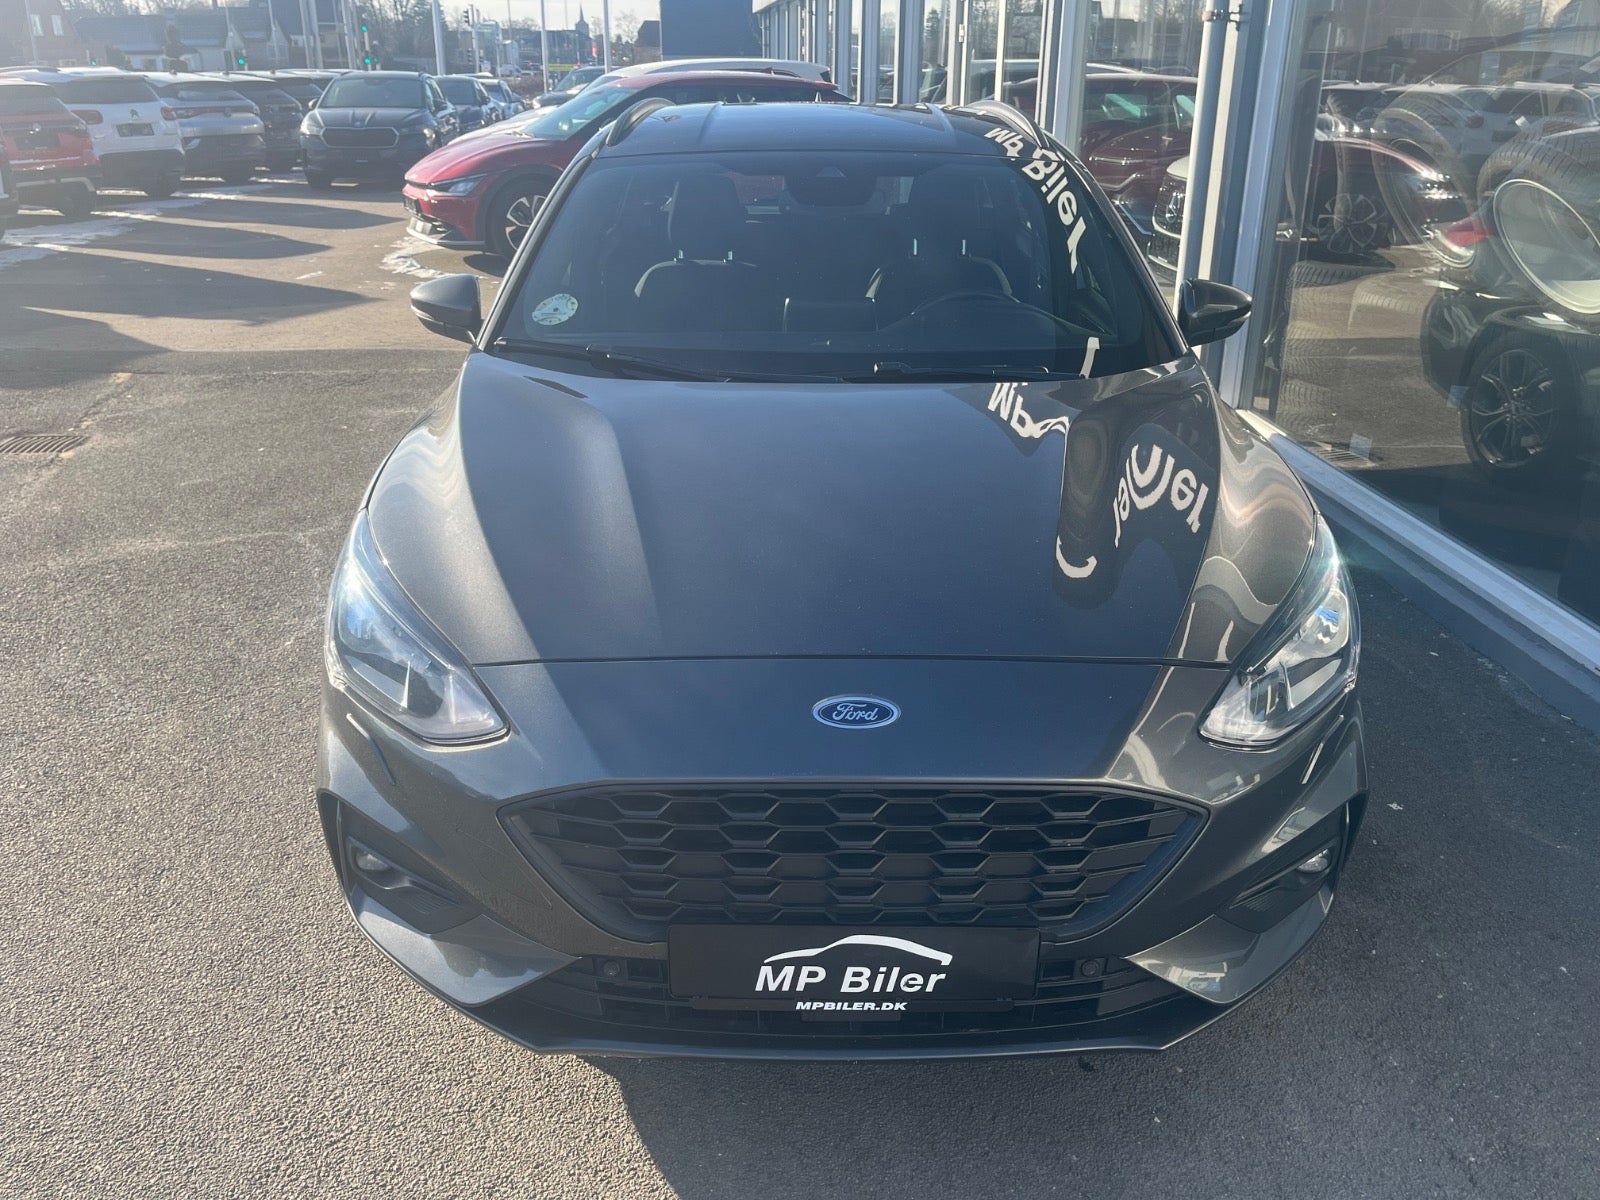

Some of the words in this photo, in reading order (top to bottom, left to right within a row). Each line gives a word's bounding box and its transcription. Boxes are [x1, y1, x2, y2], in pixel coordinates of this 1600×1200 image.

[832, 702, 879, 721] Ford
[754, 965, 827, 992] MP
[840, 966, 947, 993] Biler
[795, 1001, 908, 1011] MPBILER.DK
